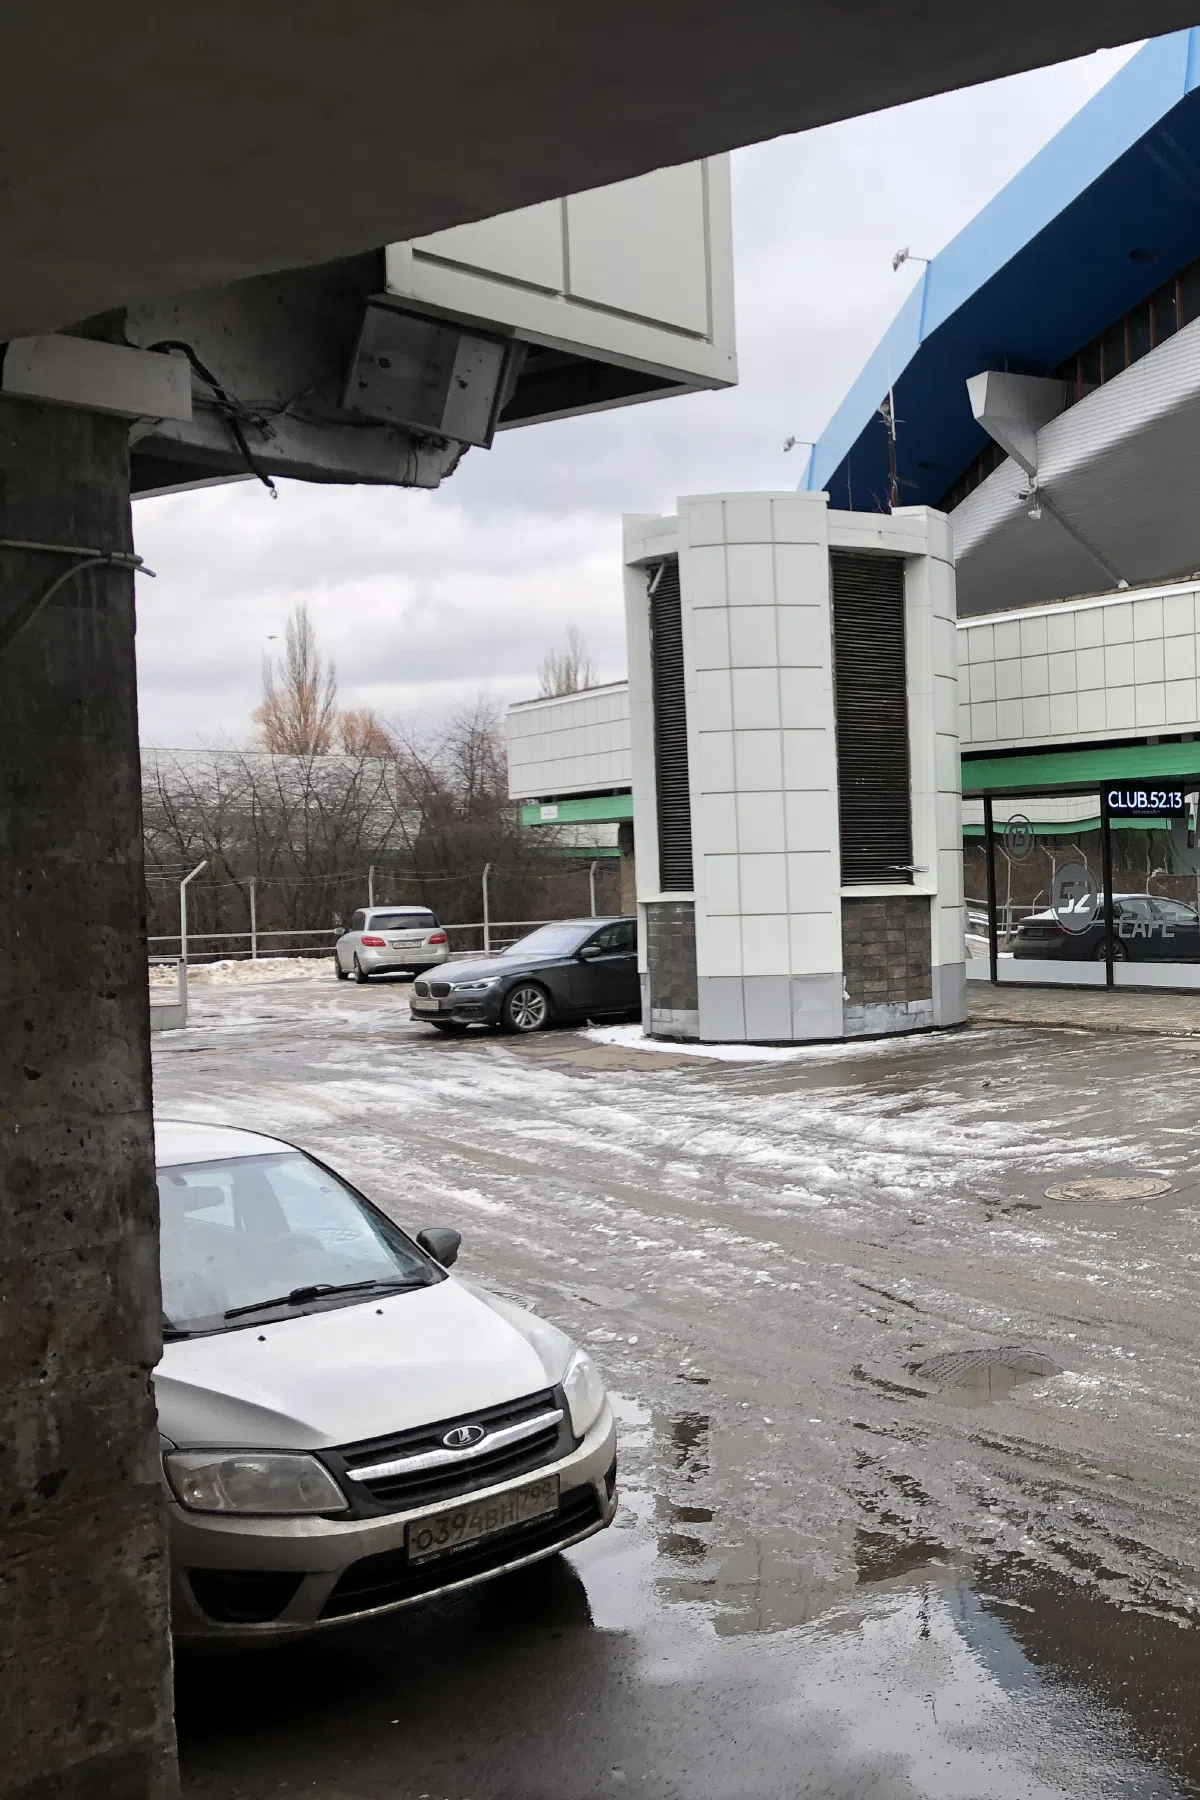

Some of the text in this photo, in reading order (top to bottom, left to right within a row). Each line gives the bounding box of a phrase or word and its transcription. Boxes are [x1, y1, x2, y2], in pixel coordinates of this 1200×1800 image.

[1108, 791, 1182, 808] CLUB.52.13
[1058, 881, 1091, 913] 52
[1118, 911, 1176, 938] CAFE
